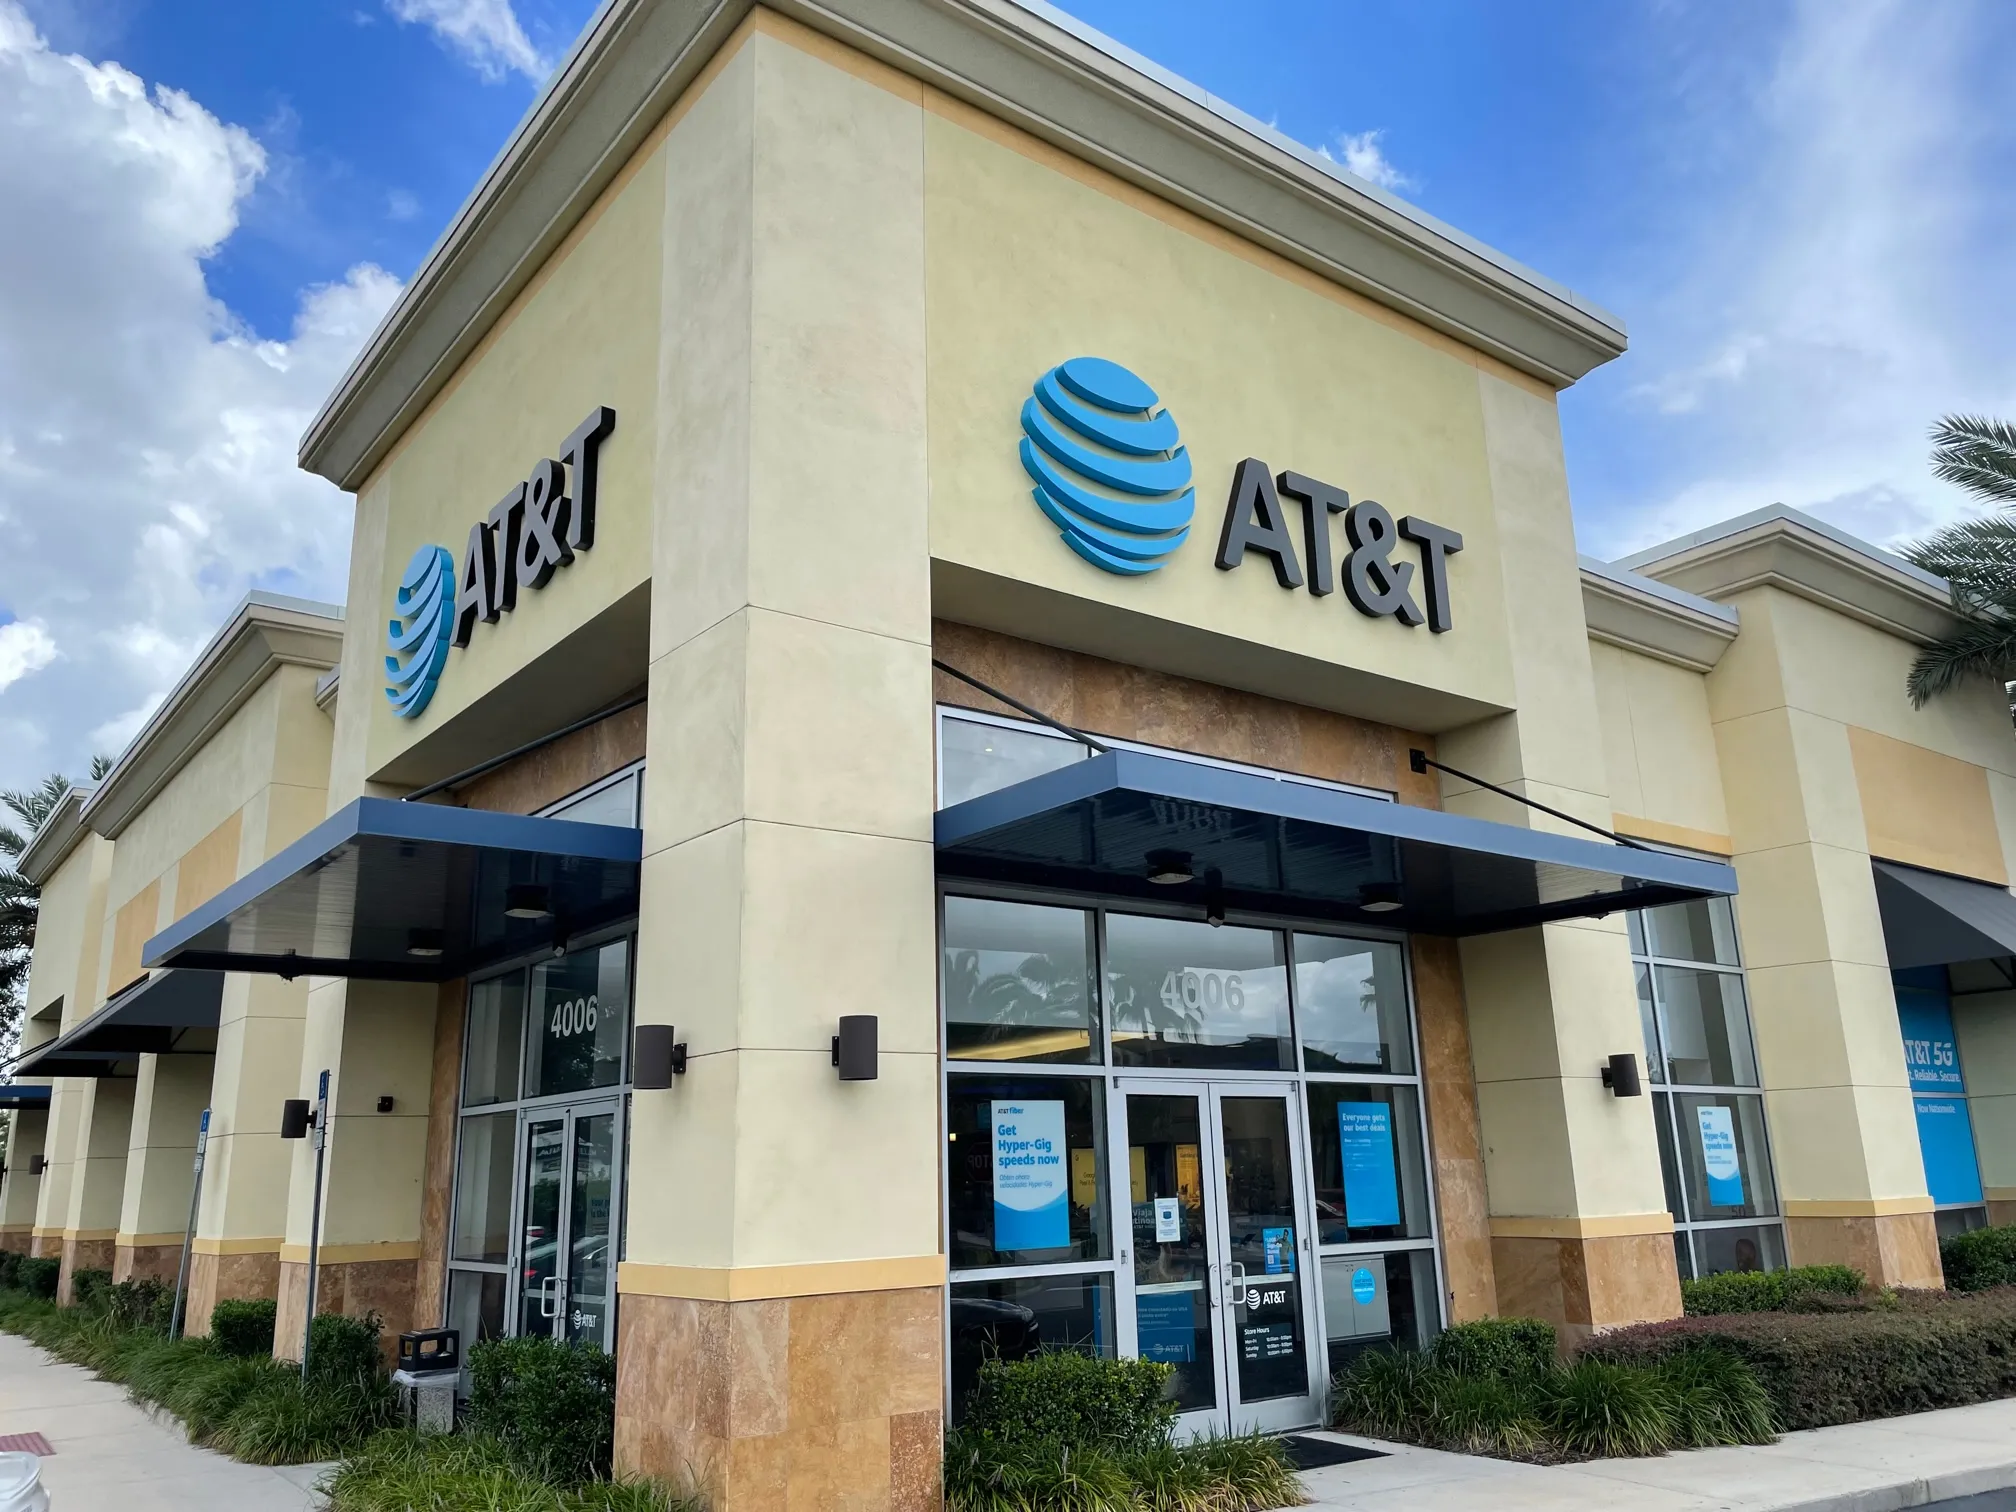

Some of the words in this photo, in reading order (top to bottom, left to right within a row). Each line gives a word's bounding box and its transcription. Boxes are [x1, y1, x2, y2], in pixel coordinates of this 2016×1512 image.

[451, 405, 616, 649] AT&T
[1214, 457, 1464, 634] AT&T
[1160, 971, 1244, 1011] 4006
[551, 995, 598, 1038] 4006
[1933, 1042, 1953, 1066] 5G
[1343, 1113, 1371, 1123] Everyone
[998, 1125, 1017, 1136] Get
[1343, 1124, 1354, 1132] our
[1355, 1123, 1369, 1132] best
[998, 1138, 1052, 1154] Hyper-Gig
[998, 1154, 1035, 1168] speeds
[1037, 1155, 1059, 1165] now
[1263, 1291, 1286, 1305] AT&T
[582, 1314, 597, 1328] AT&T
[1244, 1328, 1256, 1336] Store
[1165, 1345, 1185, 1353] AT&T
